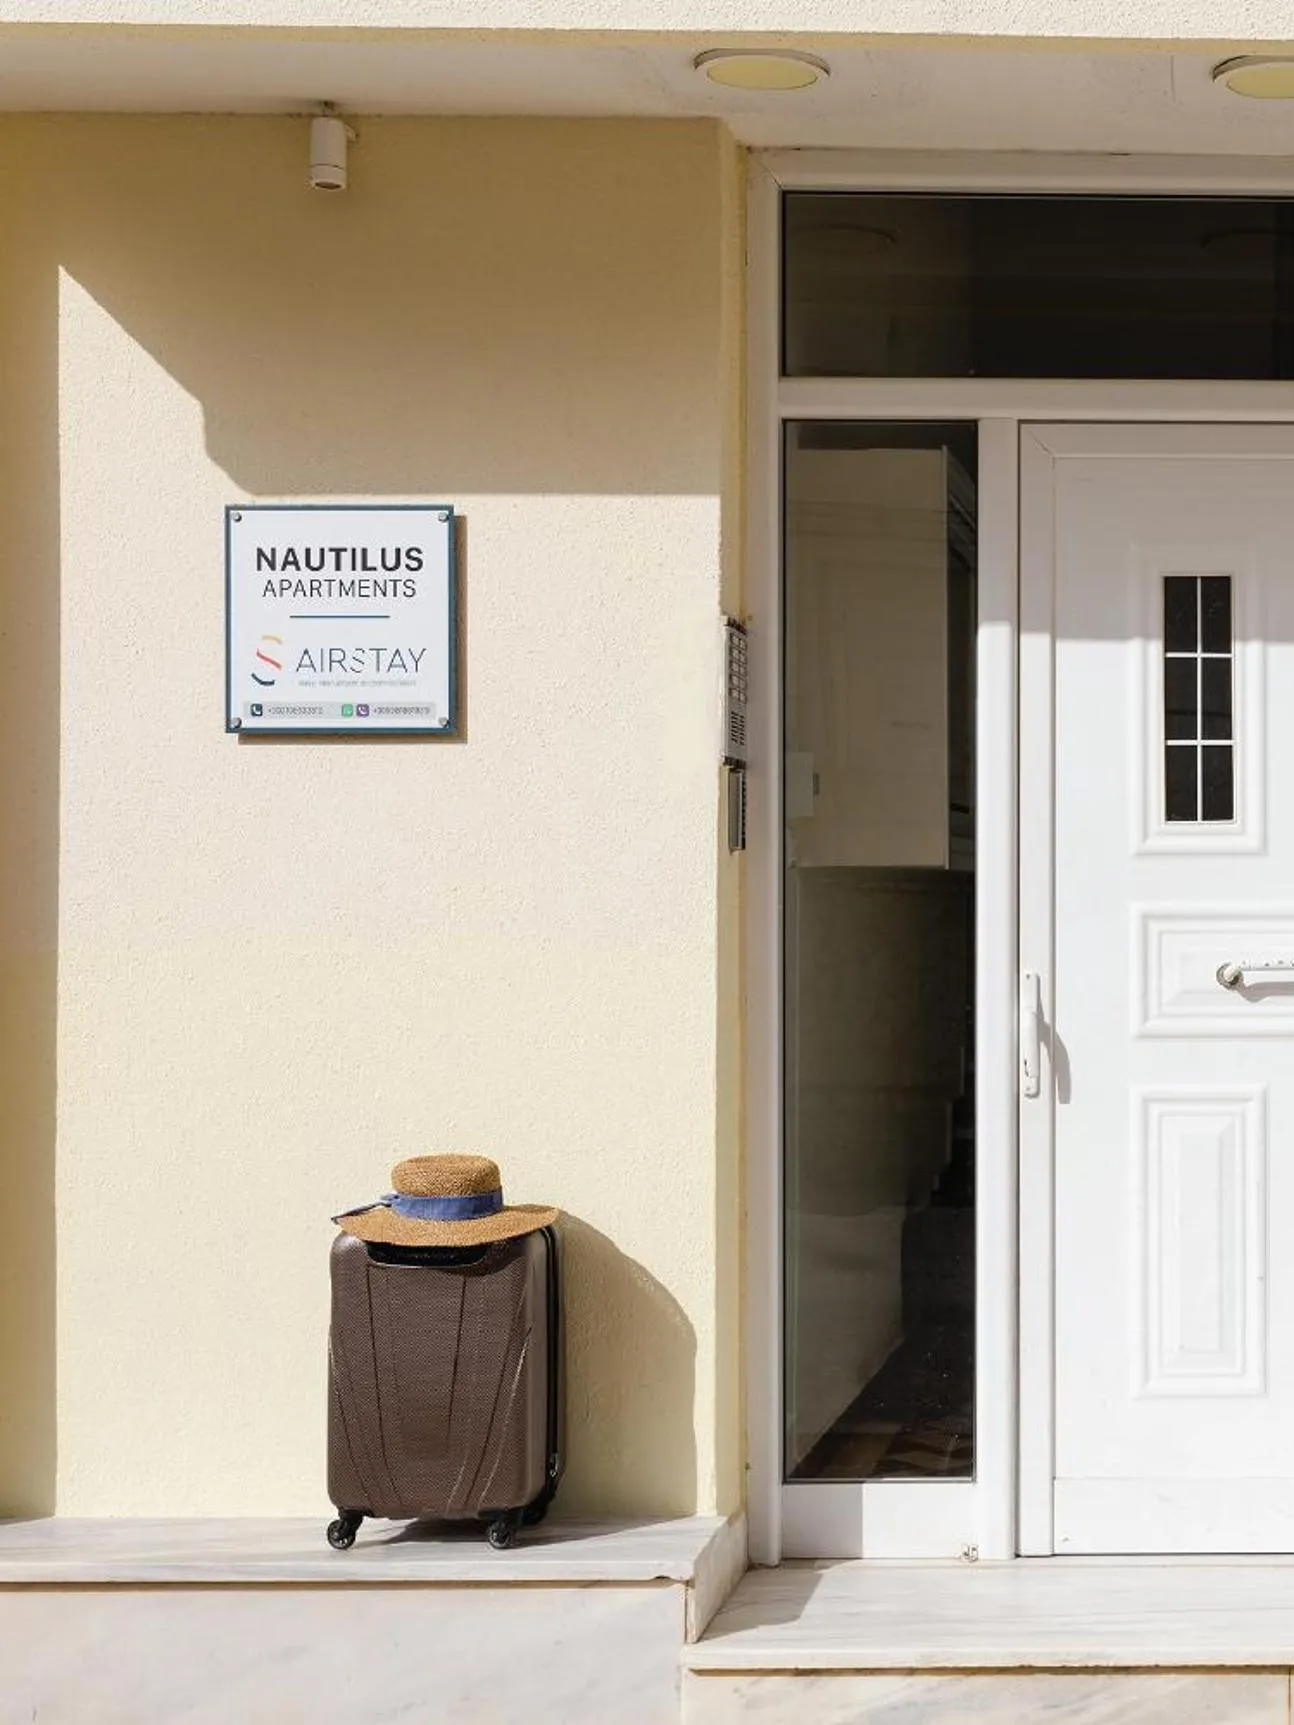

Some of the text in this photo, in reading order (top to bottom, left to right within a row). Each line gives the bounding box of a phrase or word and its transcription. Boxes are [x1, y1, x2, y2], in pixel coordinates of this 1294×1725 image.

[256, 547, 424, 572] NAUTILUS
[262, 579, 416, 598] APARTMENTS
[296, 647, 427, 674] AIRSTAY
